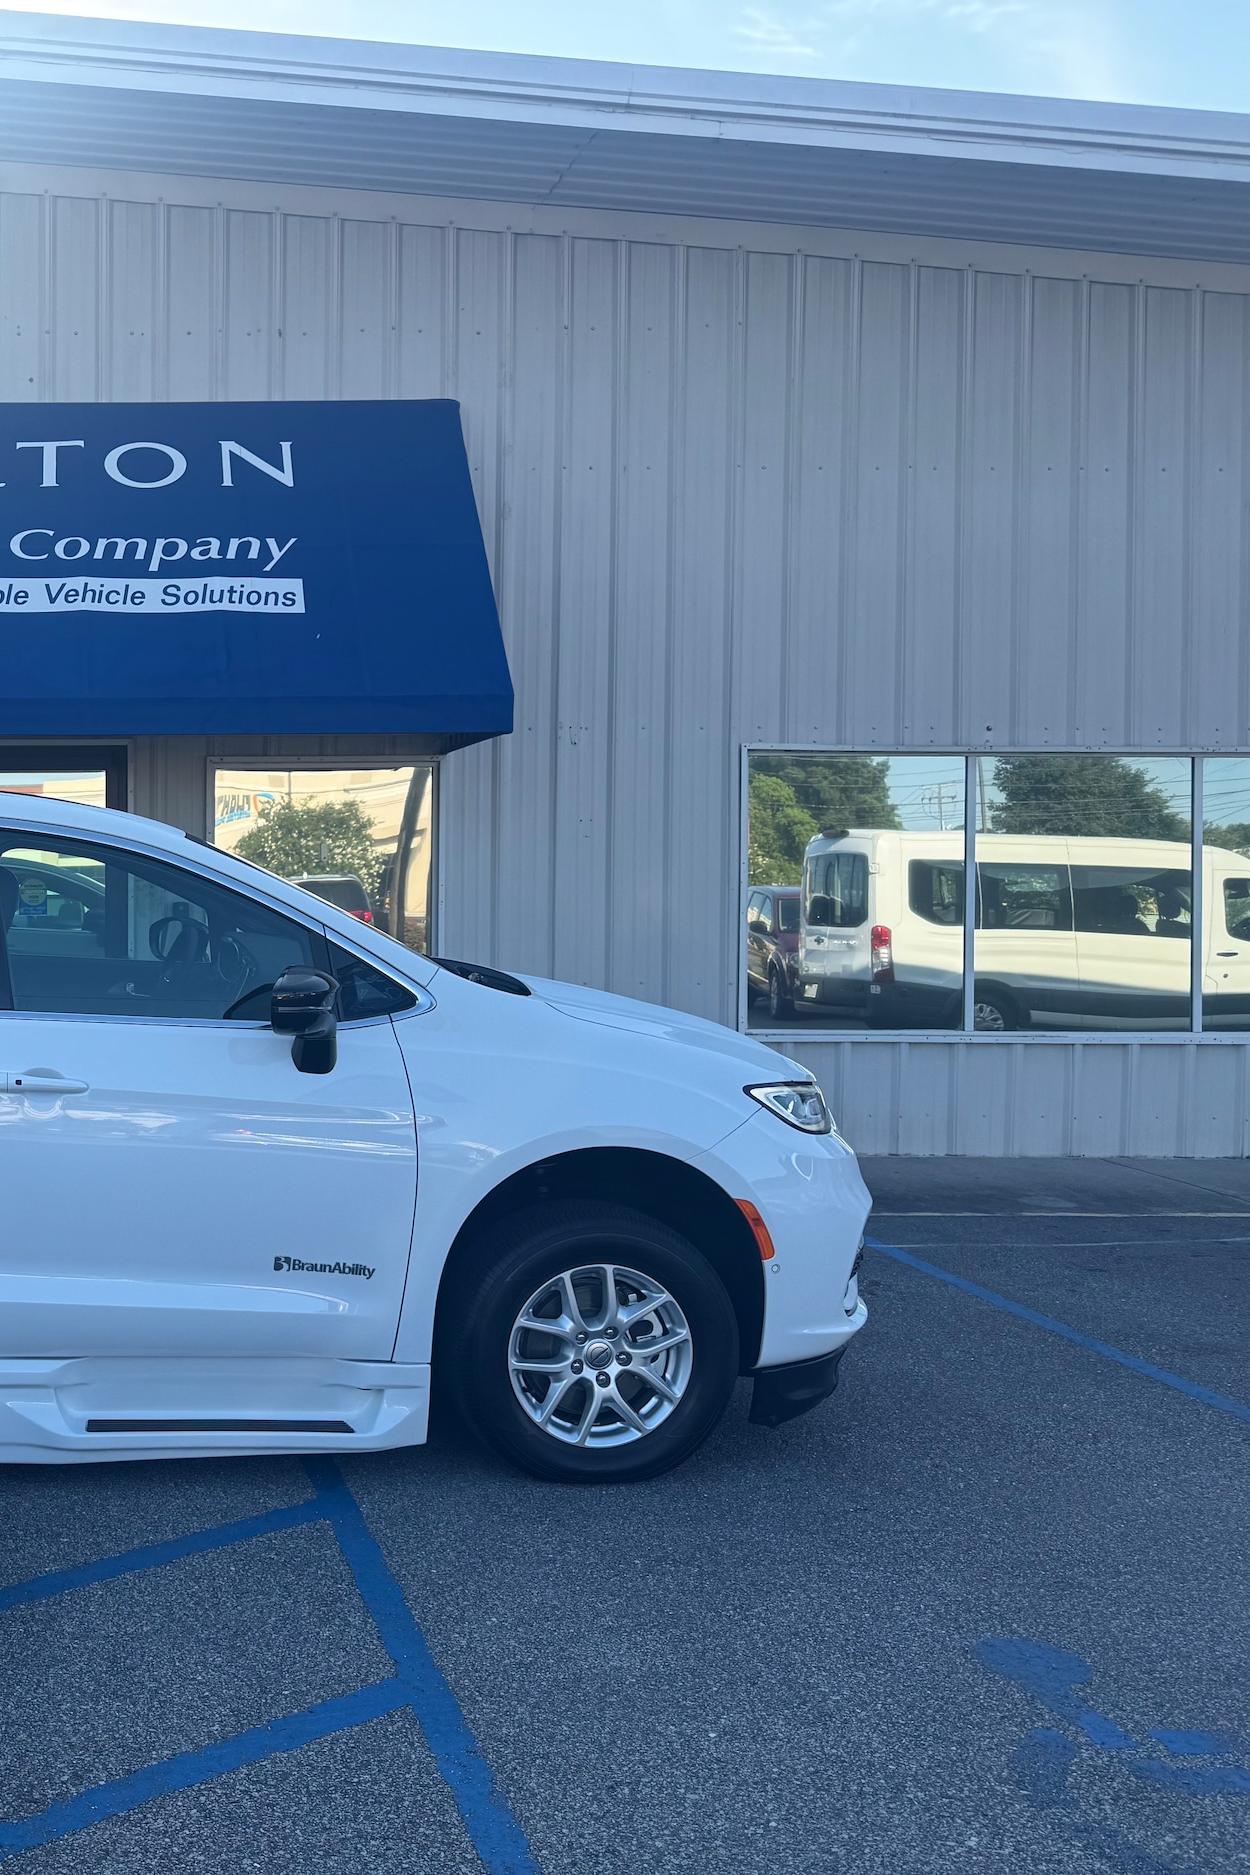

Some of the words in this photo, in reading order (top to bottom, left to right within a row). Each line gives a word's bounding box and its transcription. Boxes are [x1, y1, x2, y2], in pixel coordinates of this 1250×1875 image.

[9, 528, 298, 572] Company
[45, 582, 146, 604] Vehicle
[161, 584, 297, 606] Solutions
[291, 1258, 376, 1280] BraunAbility
